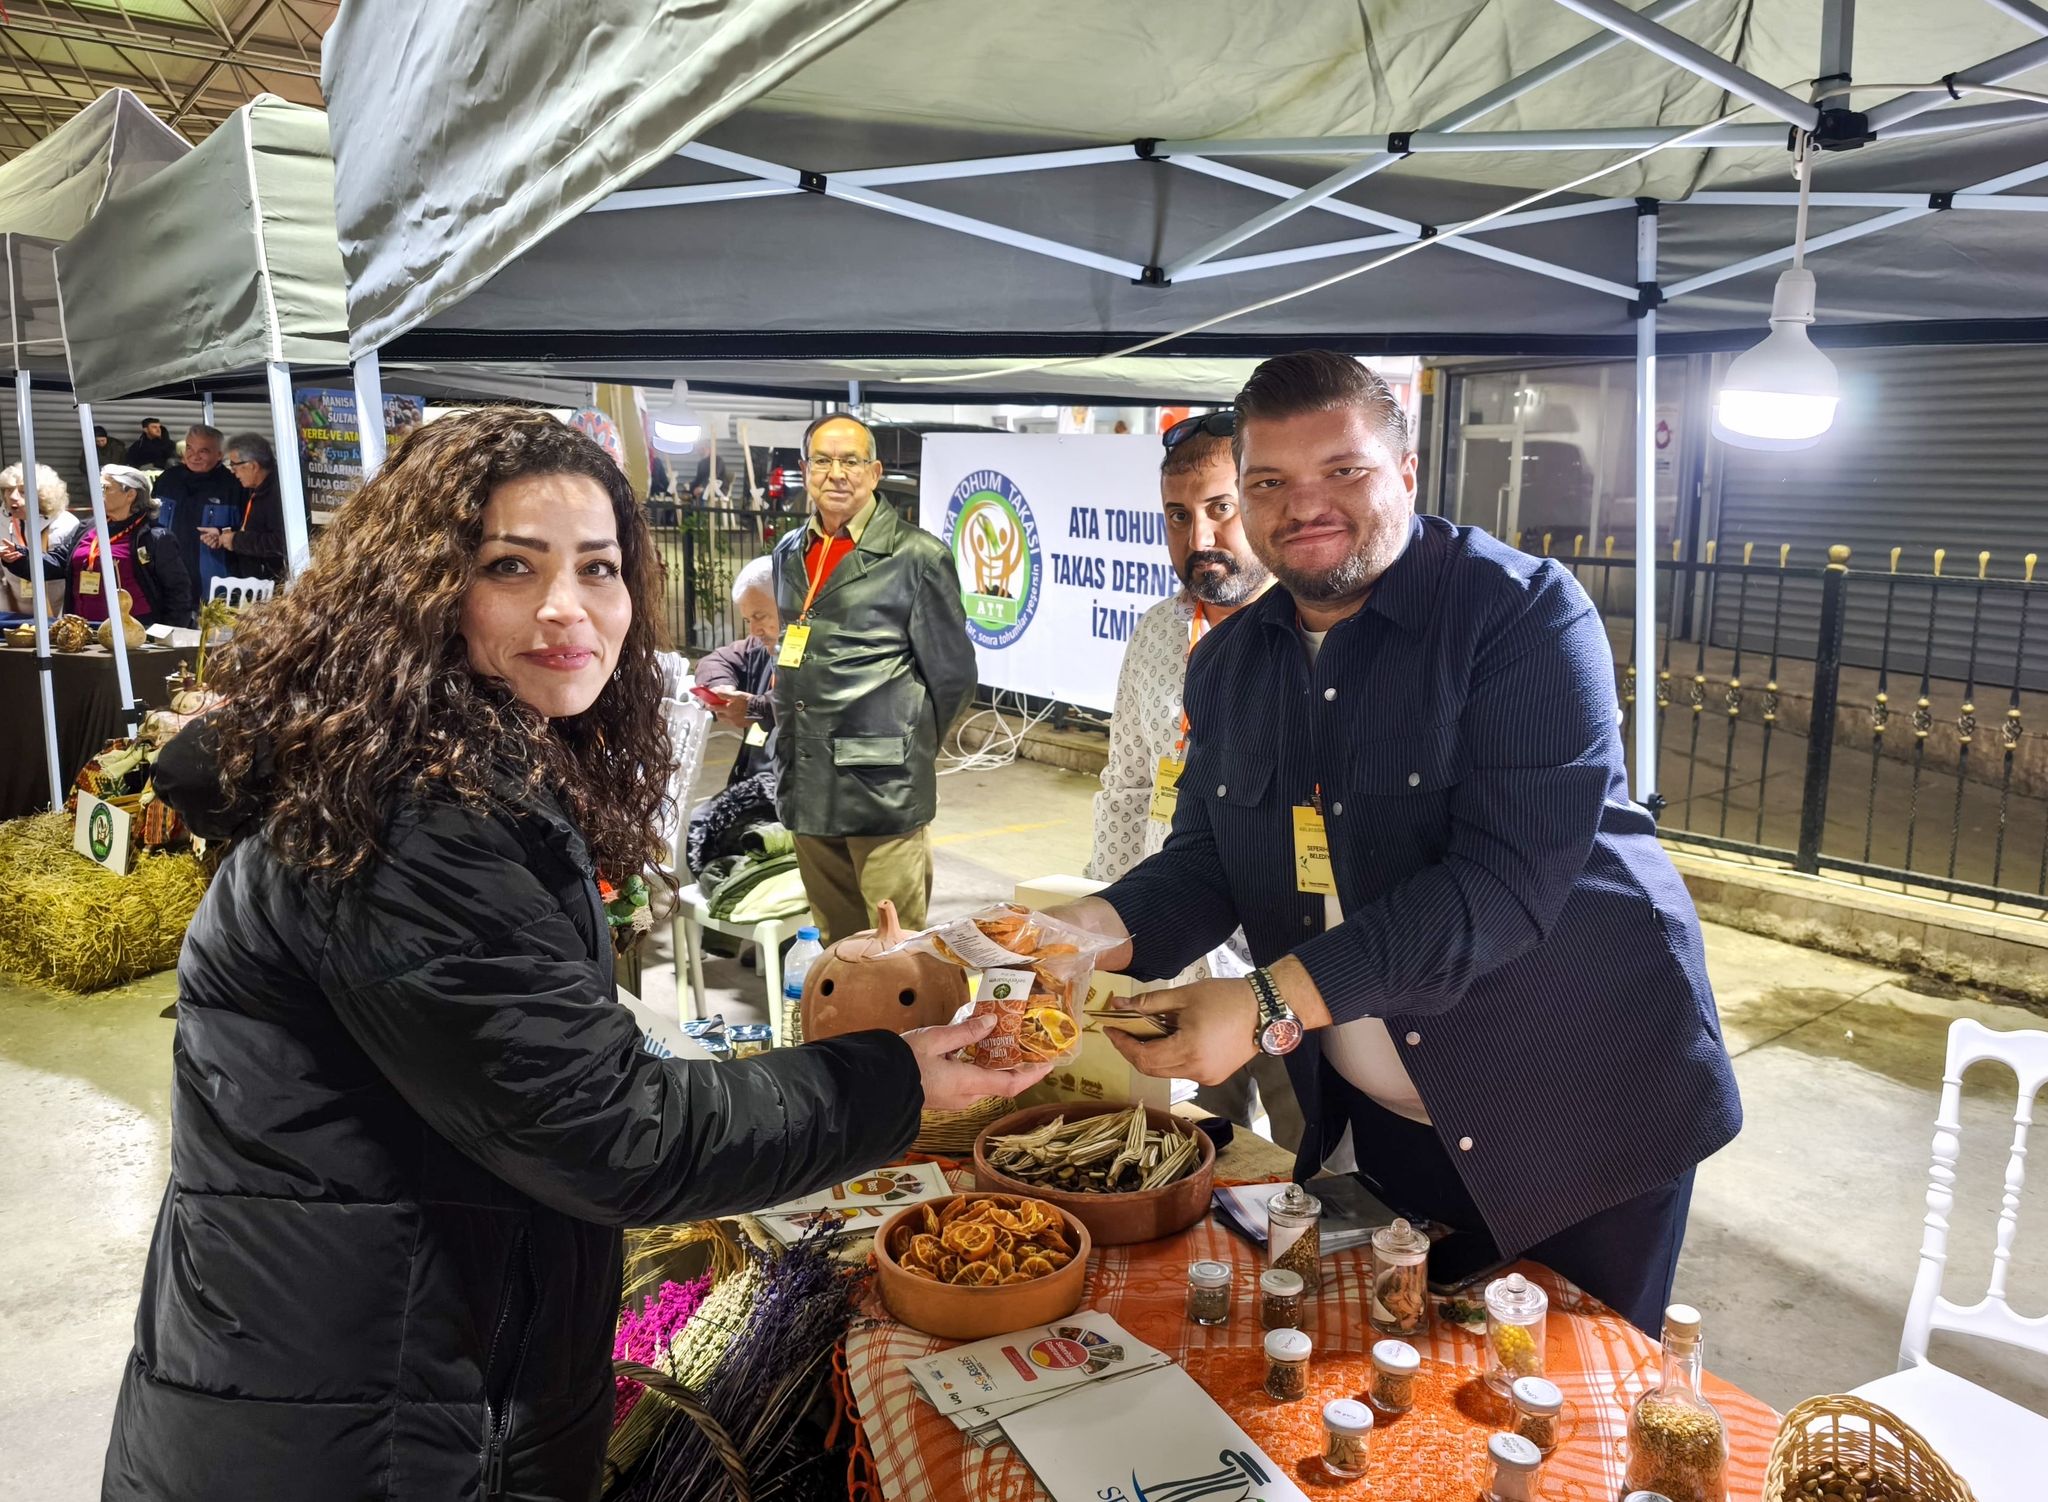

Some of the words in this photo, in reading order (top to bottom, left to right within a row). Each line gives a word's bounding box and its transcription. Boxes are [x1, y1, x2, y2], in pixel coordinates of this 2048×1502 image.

[955, 471, 1002, 505] TOHUM
[1009, 483, 1040, 555] TAKASI
[1068, 506, 1100, 540] ATA
[1051, 552, 1106, 590] TAKAS
[976, 601, 1005, 618] ATT
